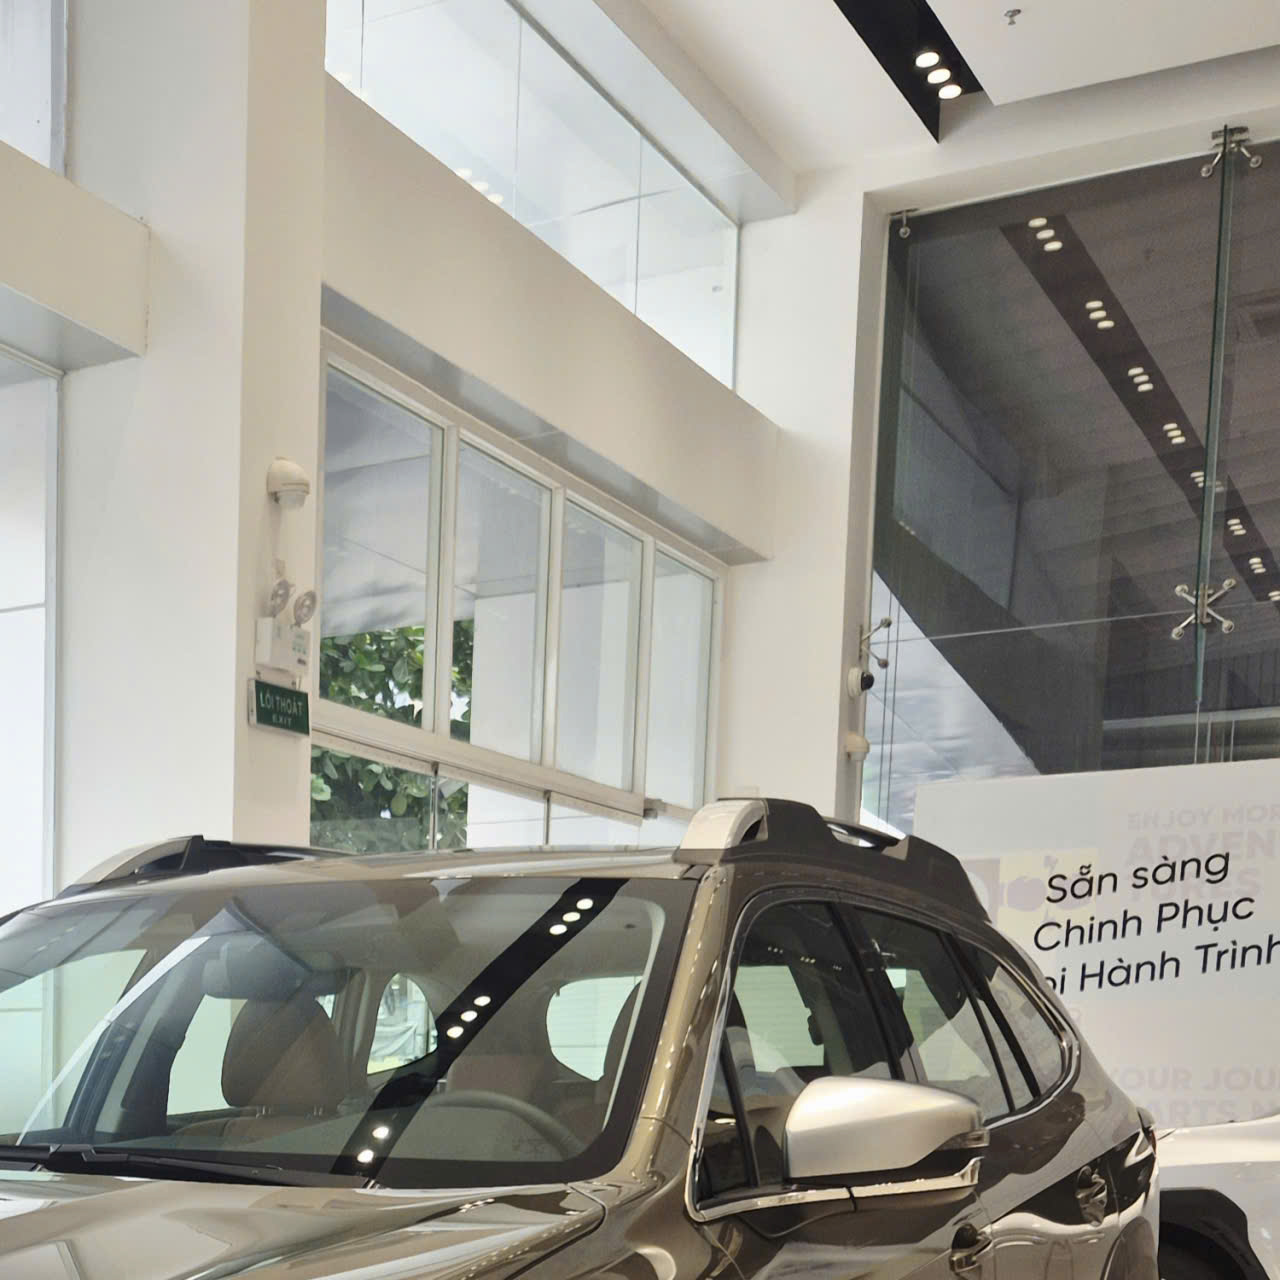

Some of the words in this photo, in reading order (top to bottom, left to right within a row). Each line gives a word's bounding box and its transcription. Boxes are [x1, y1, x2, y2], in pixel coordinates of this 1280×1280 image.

[1045, 864, 1118, 904] Sẵn
[1131, 852, 1230, 889] sàng
[1033, 909, 1142, 951] Chinh
[1156, 897, 1255, 933] Phục
[1079, 951, 1181, 992] Hành
